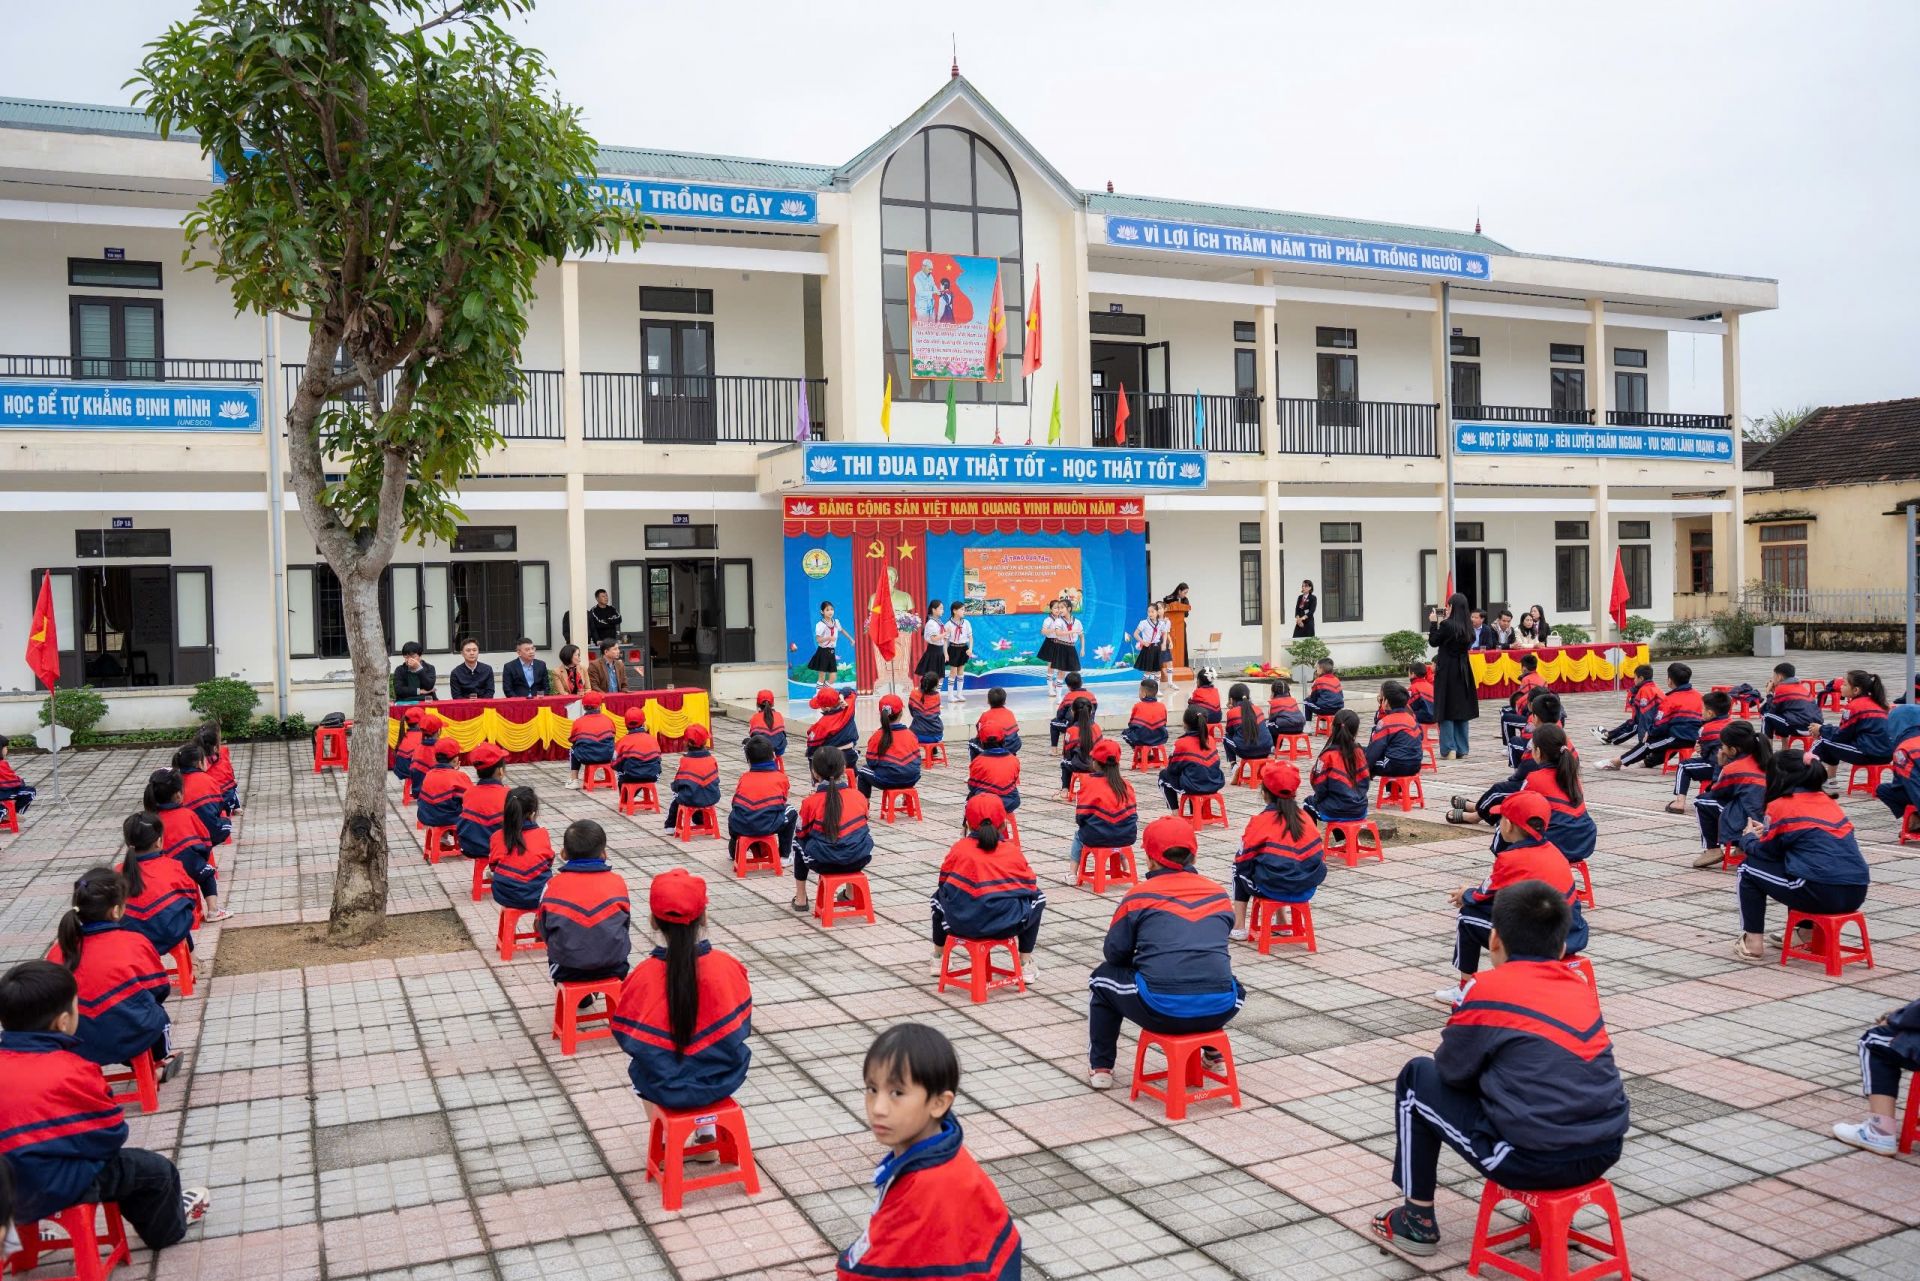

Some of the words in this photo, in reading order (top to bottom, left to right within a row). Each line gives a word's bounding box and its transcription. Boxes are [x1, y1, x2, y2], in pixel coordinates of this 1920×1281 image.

[588, 182, 642, 206] PHẢI
[649, 186, 724, 213] TRỒNG
[730, 193, 774, 216] CÂY
[1143, 226, 1160, 243] VÌ
[1164, 230, 1188, 249] LỢI
[1193, 230, 1220, 249] ÍCH
[1223, 233, 1267, 253] TRĂM
[1270, 237, 1305, 257] NĂM
[1311, 241, 1332, 259] THÌ
[1336, 242, 1369, 263] PHẢI
[1373, 245, 1417, 267] TRỒNG
[1421, 253, 1462, 272] NGƯỜI
[4, 395, 33, 418] HỌC
[38, 389, 57, 415] ĐỂ
[61, 394, 80, 419] TỰ
[84, 389, 132, 416] KHẲNG
[136, 398, 169, 420] ĐỊNH
[174, 395, 210, 417] MÌNH
[1479, 432, 1495, 450] HỌC
[1497, 430, 1511, 450] TẬP
[1512, 431, 1533, 448] SÁNG
[1535, 433, 1549, 451] TẠO
[1556, 432, 1570, 449] RÈN
[1572, 433, 1595, 452] LUYỆN
[1596, 433, 1617, 449] CHĂM
[1619, 435, 1642, 450] NGOAN
[1648, 436, 1659, 450] VUI
[1661, 436, 1676, 451] CHƠI
[1678, 435, 1695, 452] LÀNH
[1696, 440, 1714, 456] MẠNH
[842, 456, 872, 476] THI
[878, 456, 918, 476] ĐUA
[924, 456, 959, 481] DẠY
[965, 452, 1010, 481] THẬT
[1014, 451, 1046, 478] TỐT
[1063, 459, 1097, 482] HỌC
[1102, 456, 1145, 483] THẬT
[1148, 455, 1176, 480] TỐT
[819, 501, 853, 515] ĐẢNG
[857, 502, 891, 518] CỘNG
[895, 501, 920, 515] SẢN
[923, 501, 948, 518] VIỆT
[951, 503, 978, 515] NAM
[982, 503, 1022, 516] QUANG
[1024, 503, 1050, 515] VINH
[1053, 501, 1087, 515] MUÔN
[1089, 501, 1116, 515] NĂM
